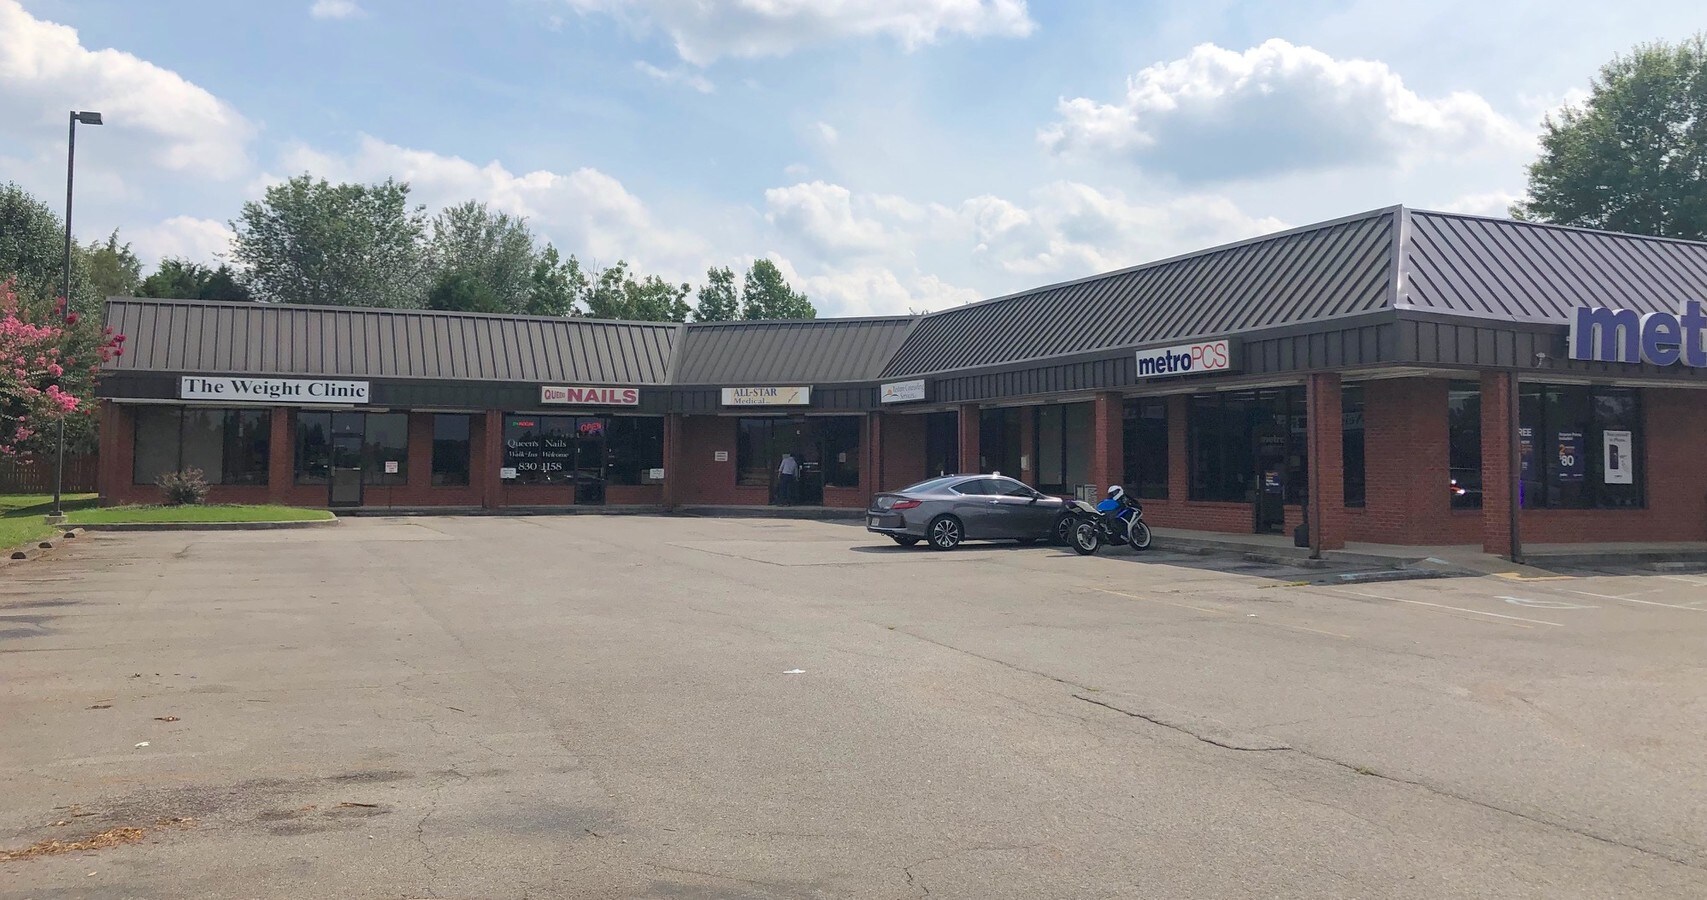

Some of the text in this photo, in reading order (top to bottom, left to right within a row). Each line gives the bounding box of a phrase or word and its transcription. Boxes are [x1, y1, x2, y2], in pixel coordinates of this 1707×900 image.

[1569, 300, 1707, 367] met
[1138, 343, 1227, 375] metroPCS
[184, 378, 366, 398] The Weight Clinic
[734, 388, 777, 397] ALL-STAR
[567, 388, 636, 403] NAILS
[580, 422, 602, 432] OPEN
[1518, 427, 1532, 437] REE
[545, 439, 567, 448] Nails
[542, 450, 570, 458] Welcome
